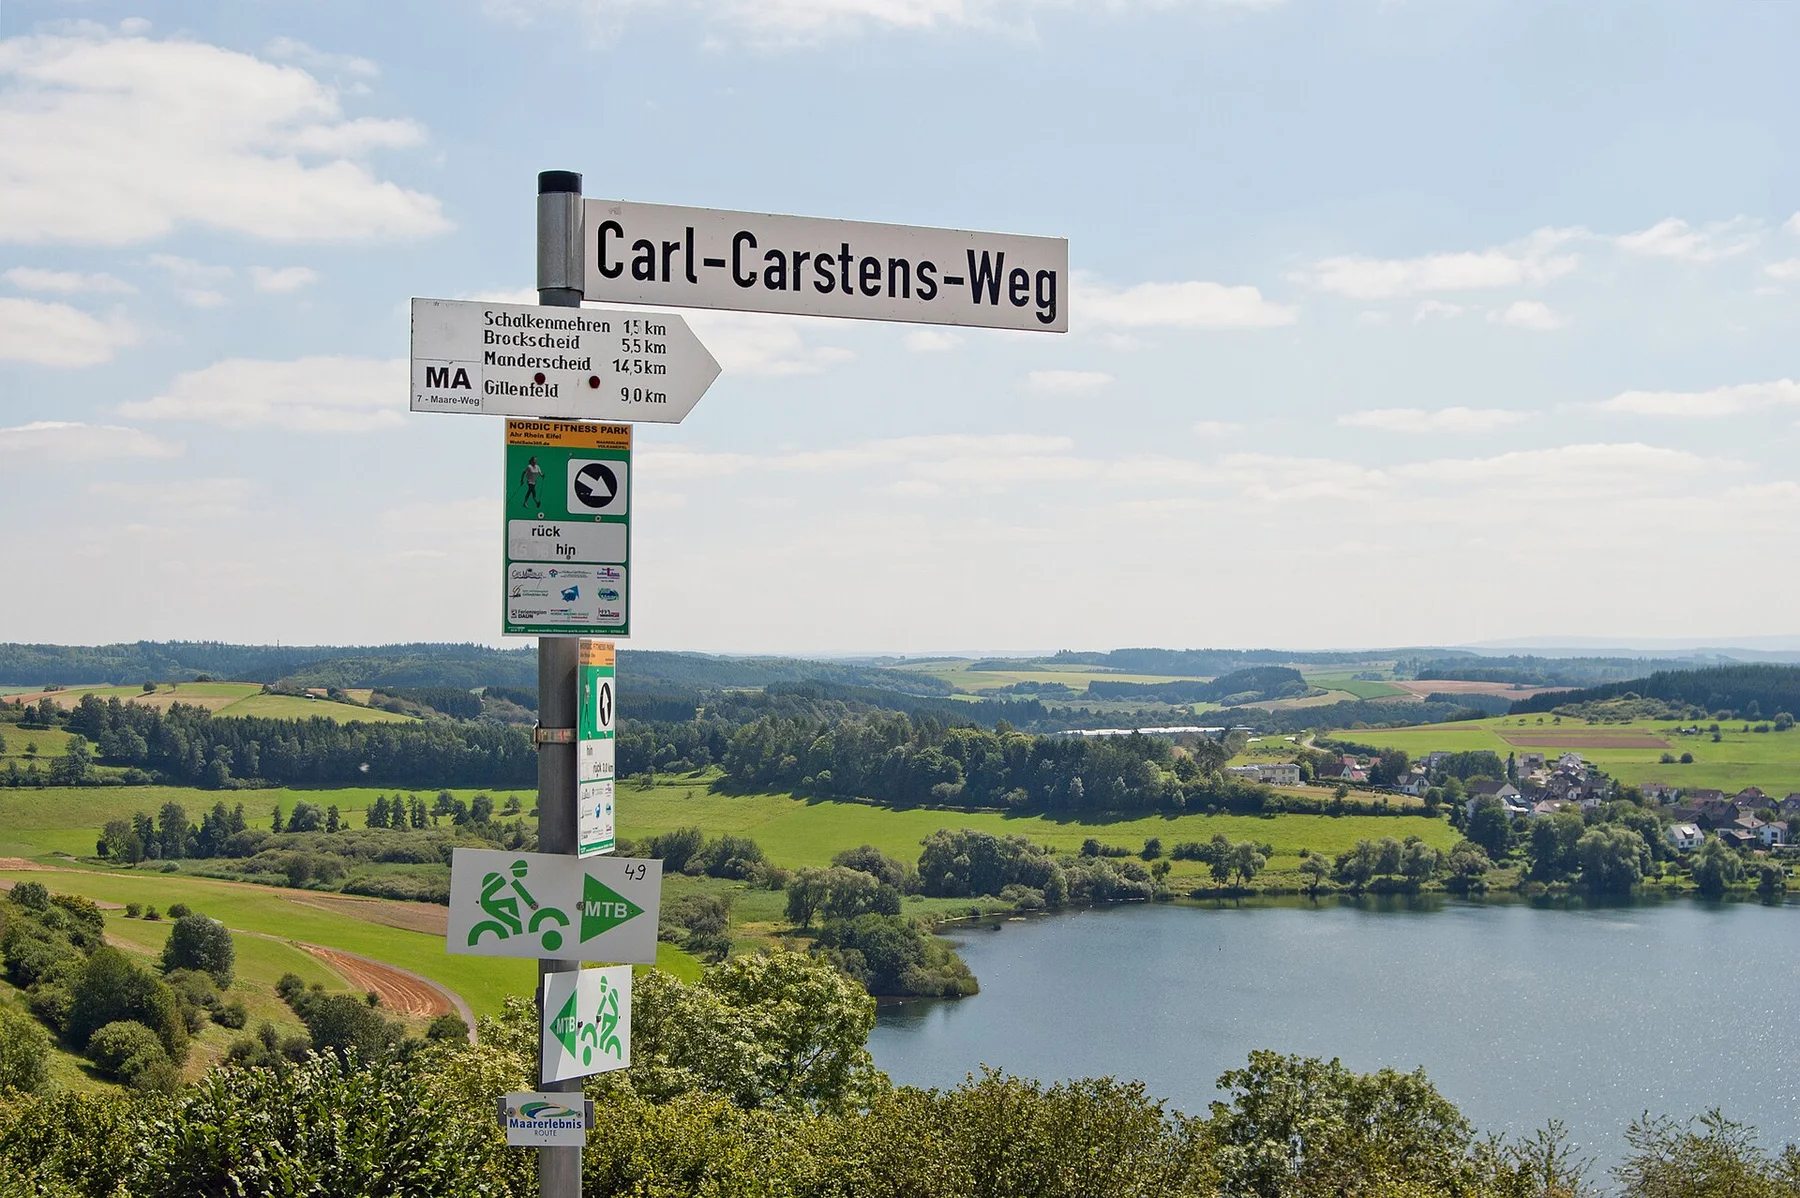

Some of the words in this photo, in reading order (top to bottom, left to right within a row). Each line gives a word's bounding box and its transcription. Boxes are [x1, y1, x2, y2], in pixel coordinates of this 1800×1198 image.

[597, 220, 1057, 324] Carl-Carstens-Weg
[484, 311, 611, 333] Schalkenmehren
[645, 320, 666, 335] km
[484, 330, 580, 350] Brockscheid
[622, 339, 642, 354] 5,5
[645, 340, 667, 354] km
[484, 351, 592, 371] Manderscheid
[612, 359, 643, 375] 14,5
[644, 360, 667, 375] km
[426, 366, 472, 390] MA
[417, 395, 422, 403] 7
[430, 395, 480, 407] Maare-Weg
[484, 380, 559, 398] Gillenfeld
[621, 387, 642, 404] 9,0
[645, 388, 667, 403] km
[509, 421, 551, 431] NORDIC
[554, 423, 598, 433] FITNESS
[601, 426, 628, 435] PARK
[532, 525, 561, 537] rück
[556, 544, 576, 555] hin
[625, 863, 647, 881] 49
[585, 901, 628, 918] MTB
[556, 1018, 577, 1036] MTB
[510, 1118, 582, 1130] Maarerlebnis
[534, 1129, 557, 1137] ROUTE
